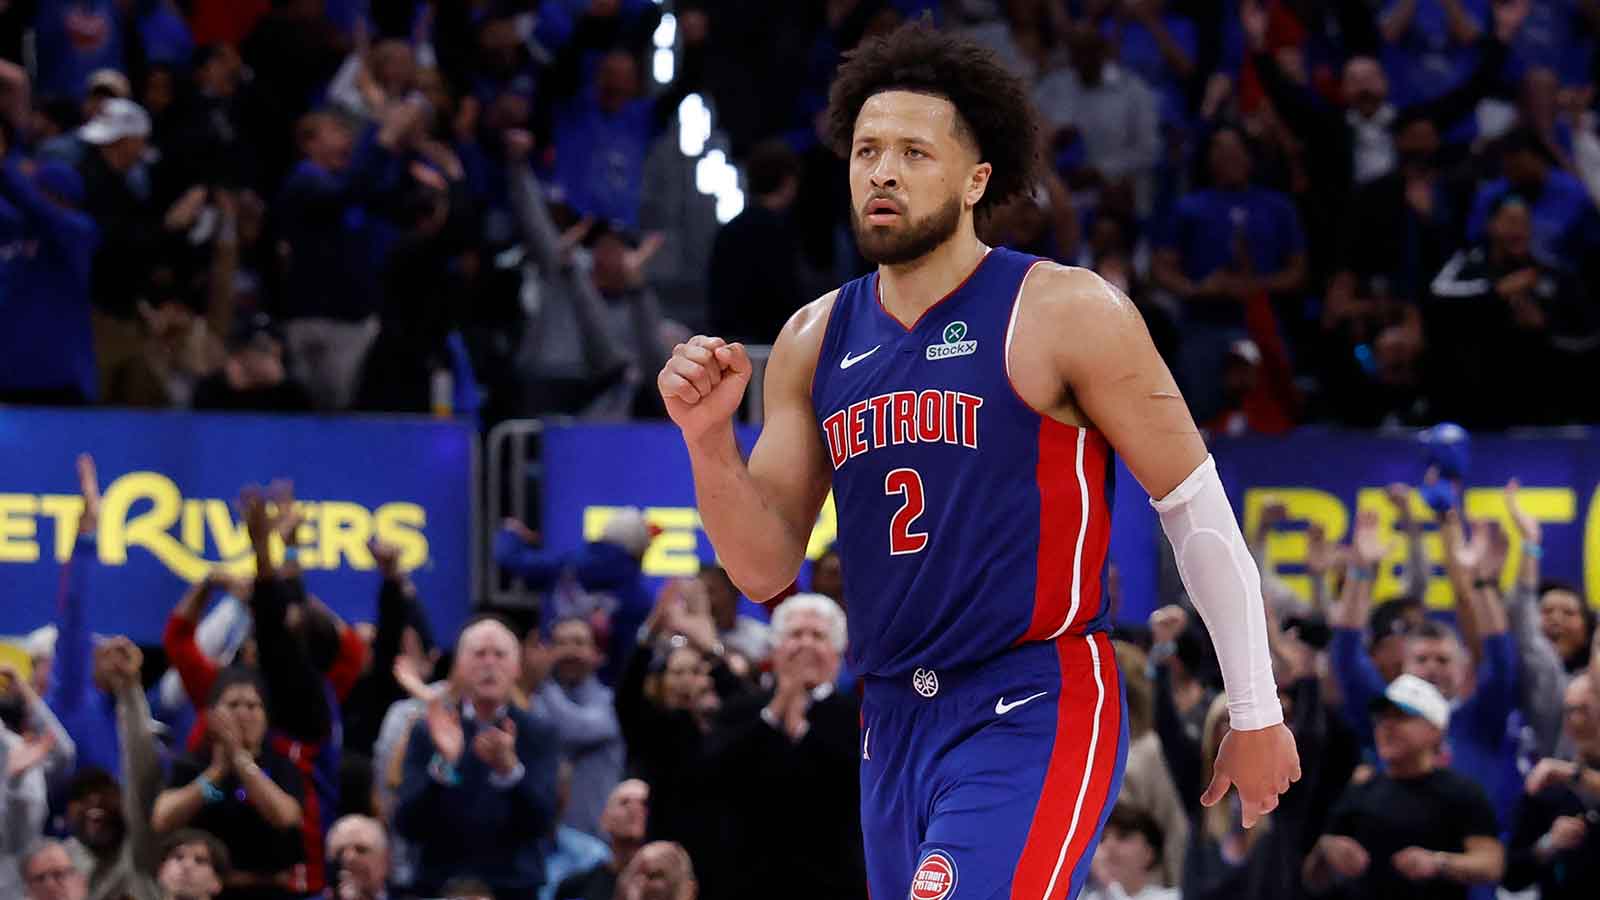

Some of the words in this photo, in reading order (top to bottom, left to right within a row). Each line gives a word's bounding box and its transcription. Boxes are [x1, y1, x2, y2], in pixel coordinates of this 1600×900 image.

[928, 342, 976, 358] StockX
[823, 390, 984, 471] DETROIT
[885, 468, 929, 555] 2
[1244, 487, 1600, 611] BET
[914, 881, 943, 892] PISTONS
[918, 871, 946, 882] DETROIT
